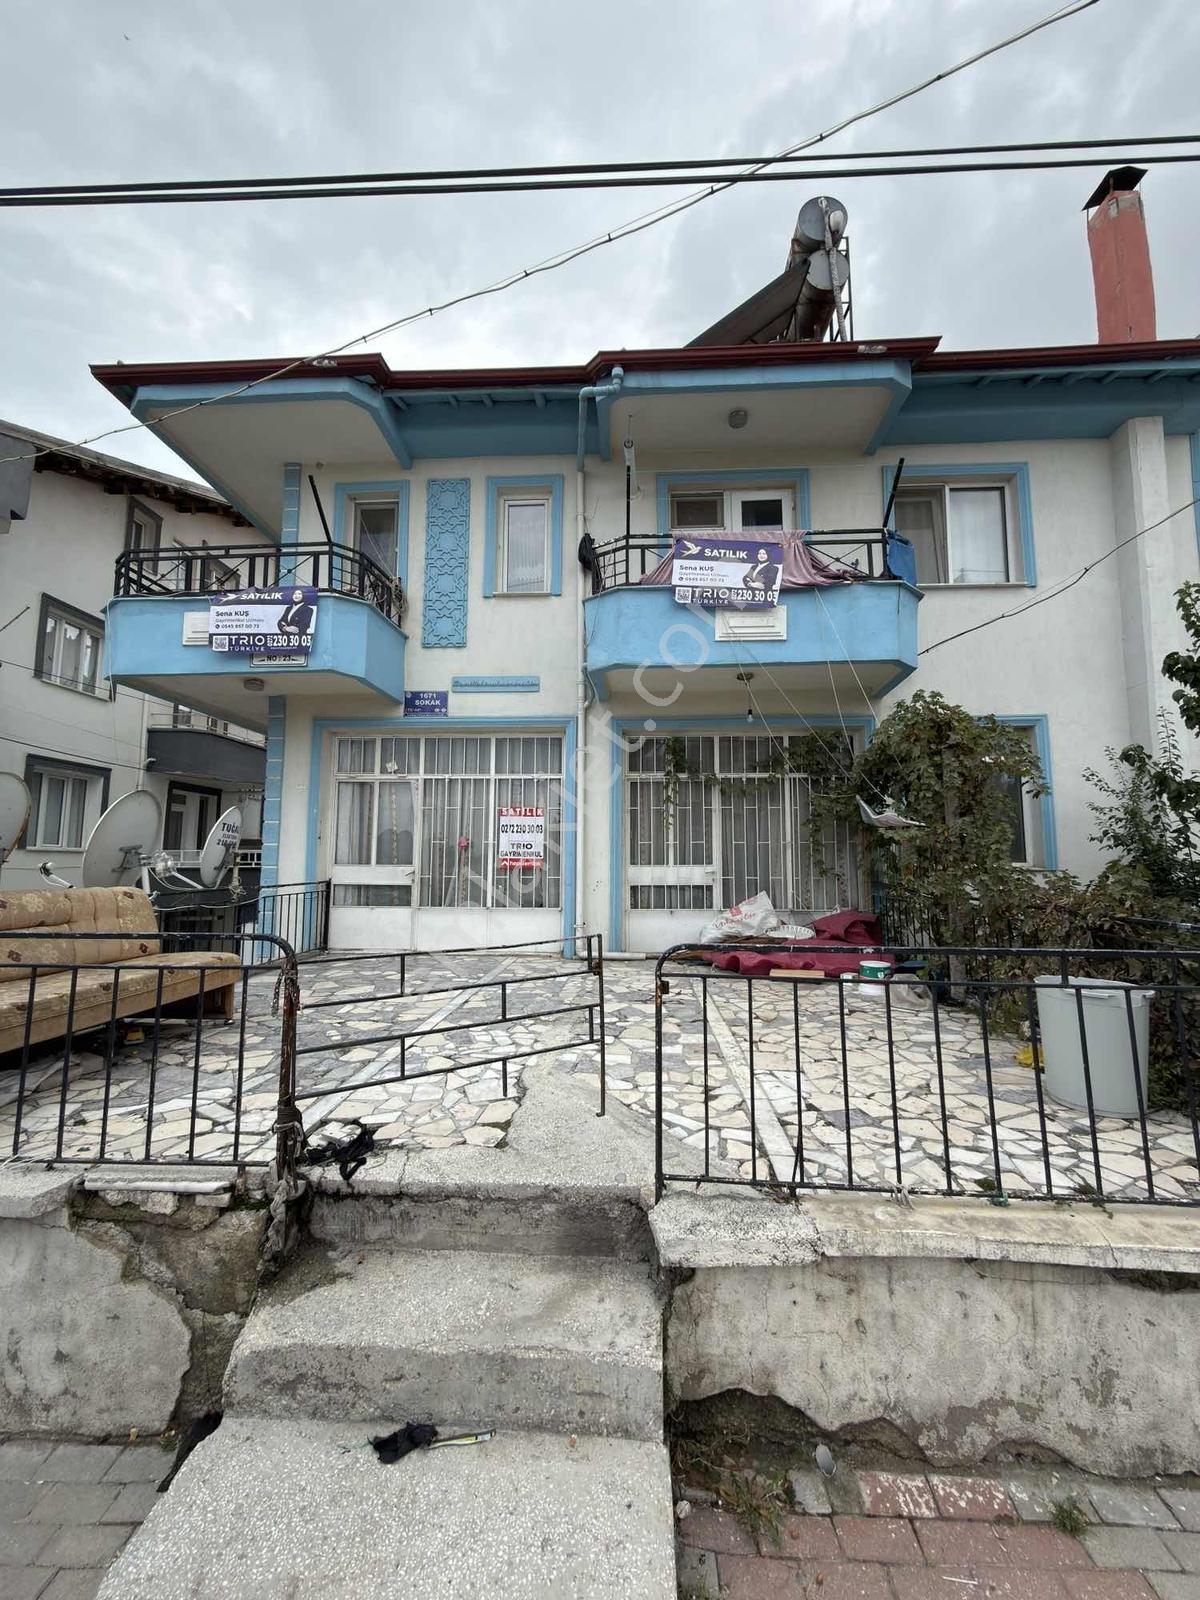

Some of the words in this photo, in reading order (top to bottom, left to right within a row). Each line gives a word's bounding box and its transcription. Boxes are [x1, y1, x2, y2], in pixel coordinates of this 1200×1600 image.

[704, 548, 748, 559] SATILIK
[240, 592, 283, 600] SATILIK
[692, 588, 730, 599] TRIO
[738, 590, 753, 601] 230
[754, 590, 765, 601] 30
[767, 590, 778, 602] 03
[229, 635, 265, 645] TRIO
[273, 635, 288, 647] 230
[289, 635, 300, 647] 30
[301, 635, 312, 647] 03
[501, 807, 544, 816] SATILIK
[510, 842, 533, 850] TRIO
